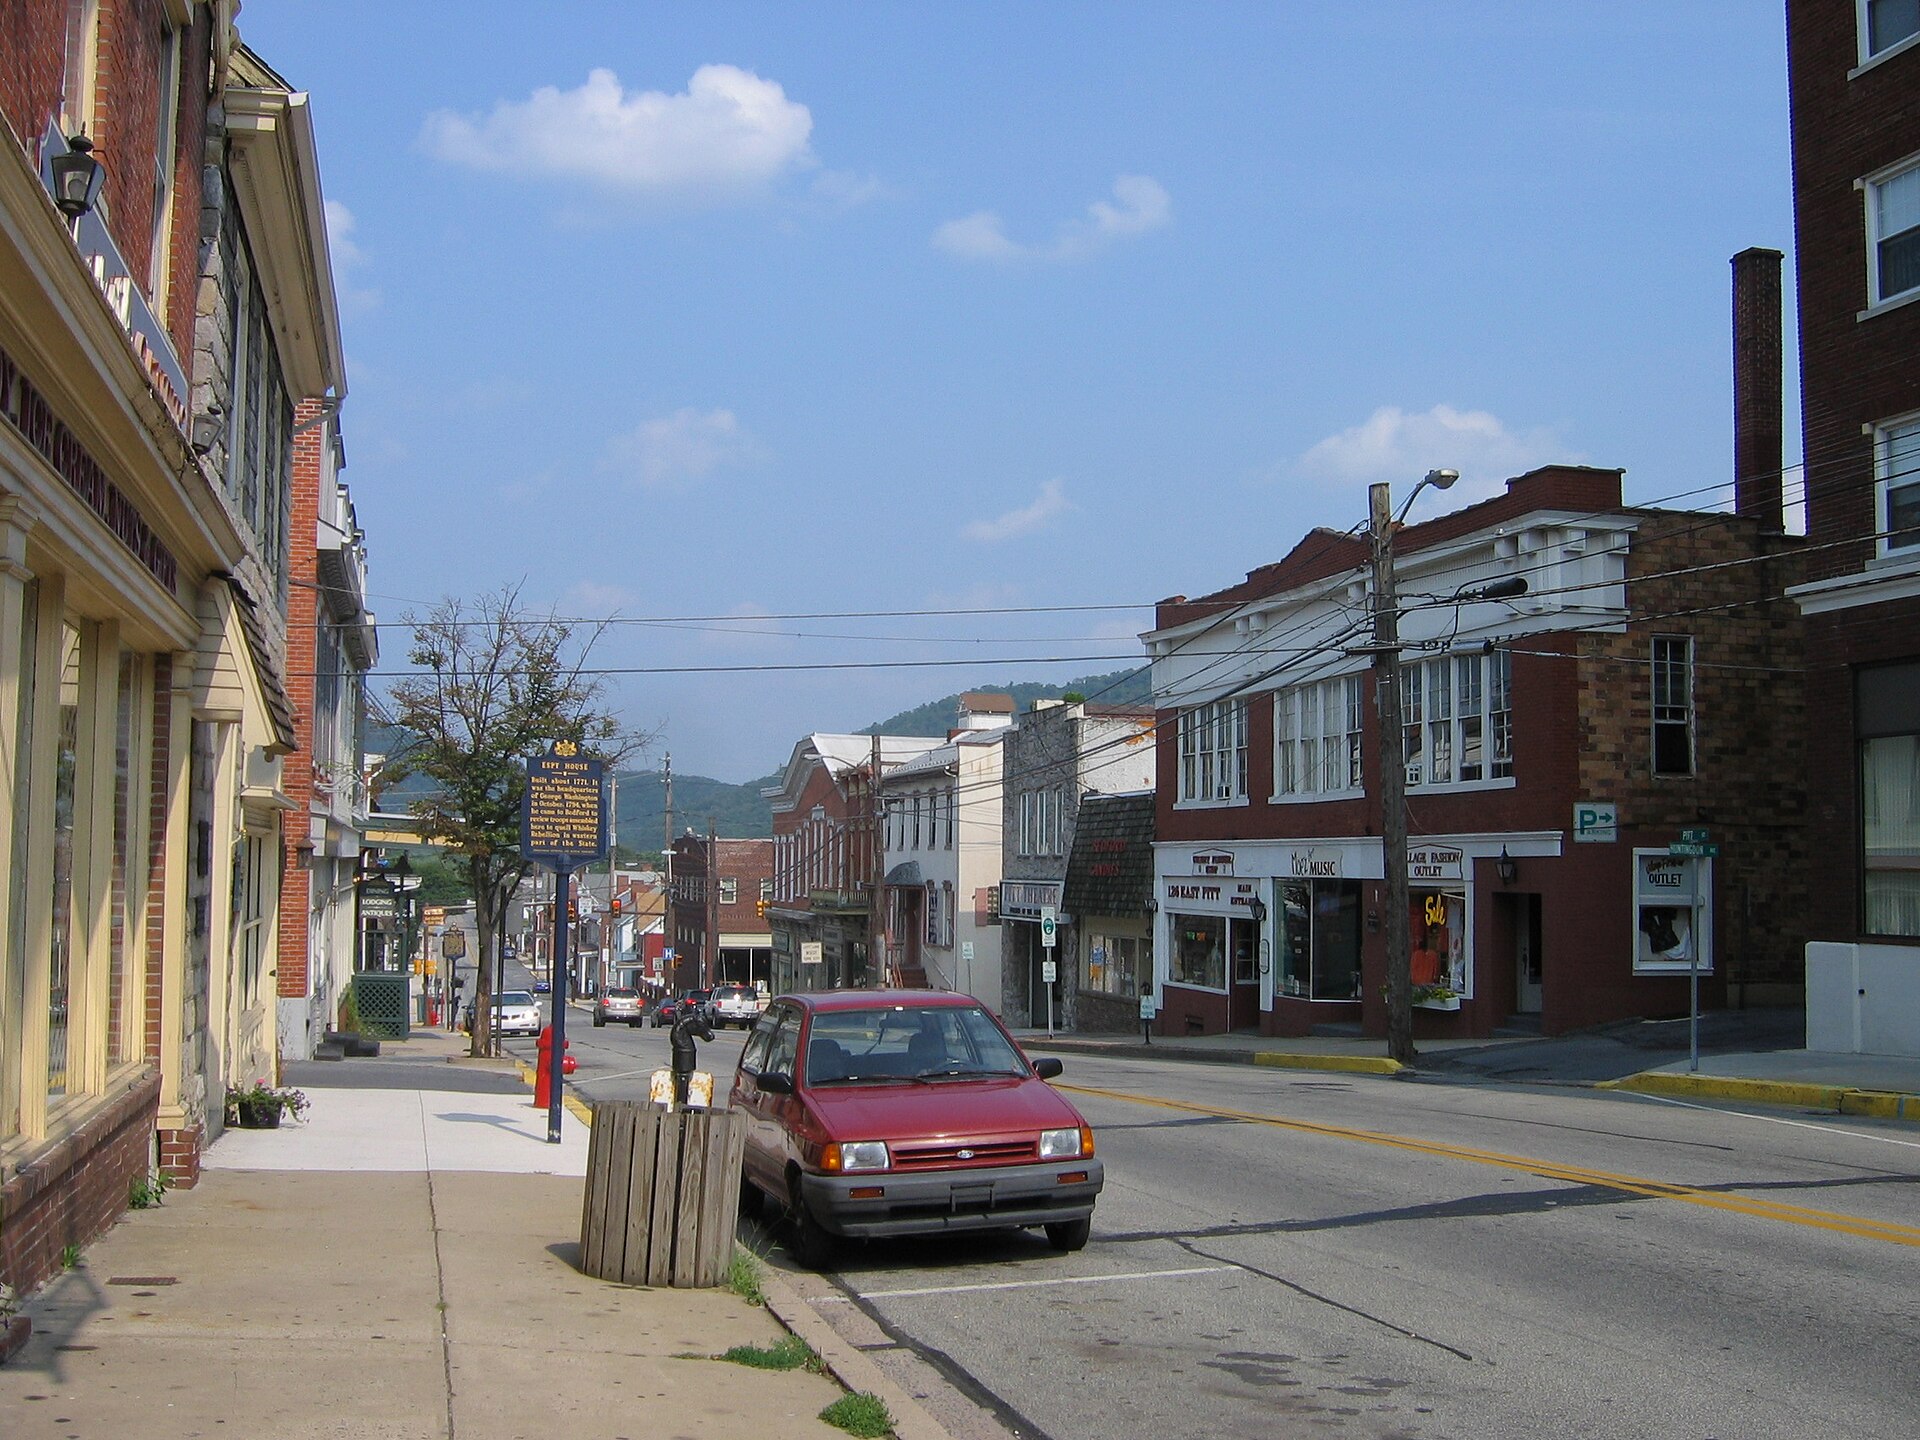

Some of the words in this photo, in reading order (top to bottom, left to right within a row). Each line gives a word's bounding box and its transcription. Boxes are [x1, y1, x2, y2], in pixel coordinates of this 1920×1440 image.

[564, 762, 588, 771] HOUSE
[556, 785, 598, 793] headquarters
[540, 792, 562, 801] George
[563, 793, 598, 802] Washington
[549, 839, 558, 847] of
[562, 839, 574, 847] the
[1431, 852, 1460, 863] FASHION
[1309, 861, 1335, 876] MUSIC
[1414, 866, 1442, 876] OUTLET
[1649, 873, 1682, 884] OUTLET
[1024, 886, 1057, 905] THEATRE
[1180, 885, 1200, 899] EAST
[1202, 886, 1220, 900] PITT
[362, 898, 392, 906] LODGING
[361, 909, 393, 918] ANTIQUES
